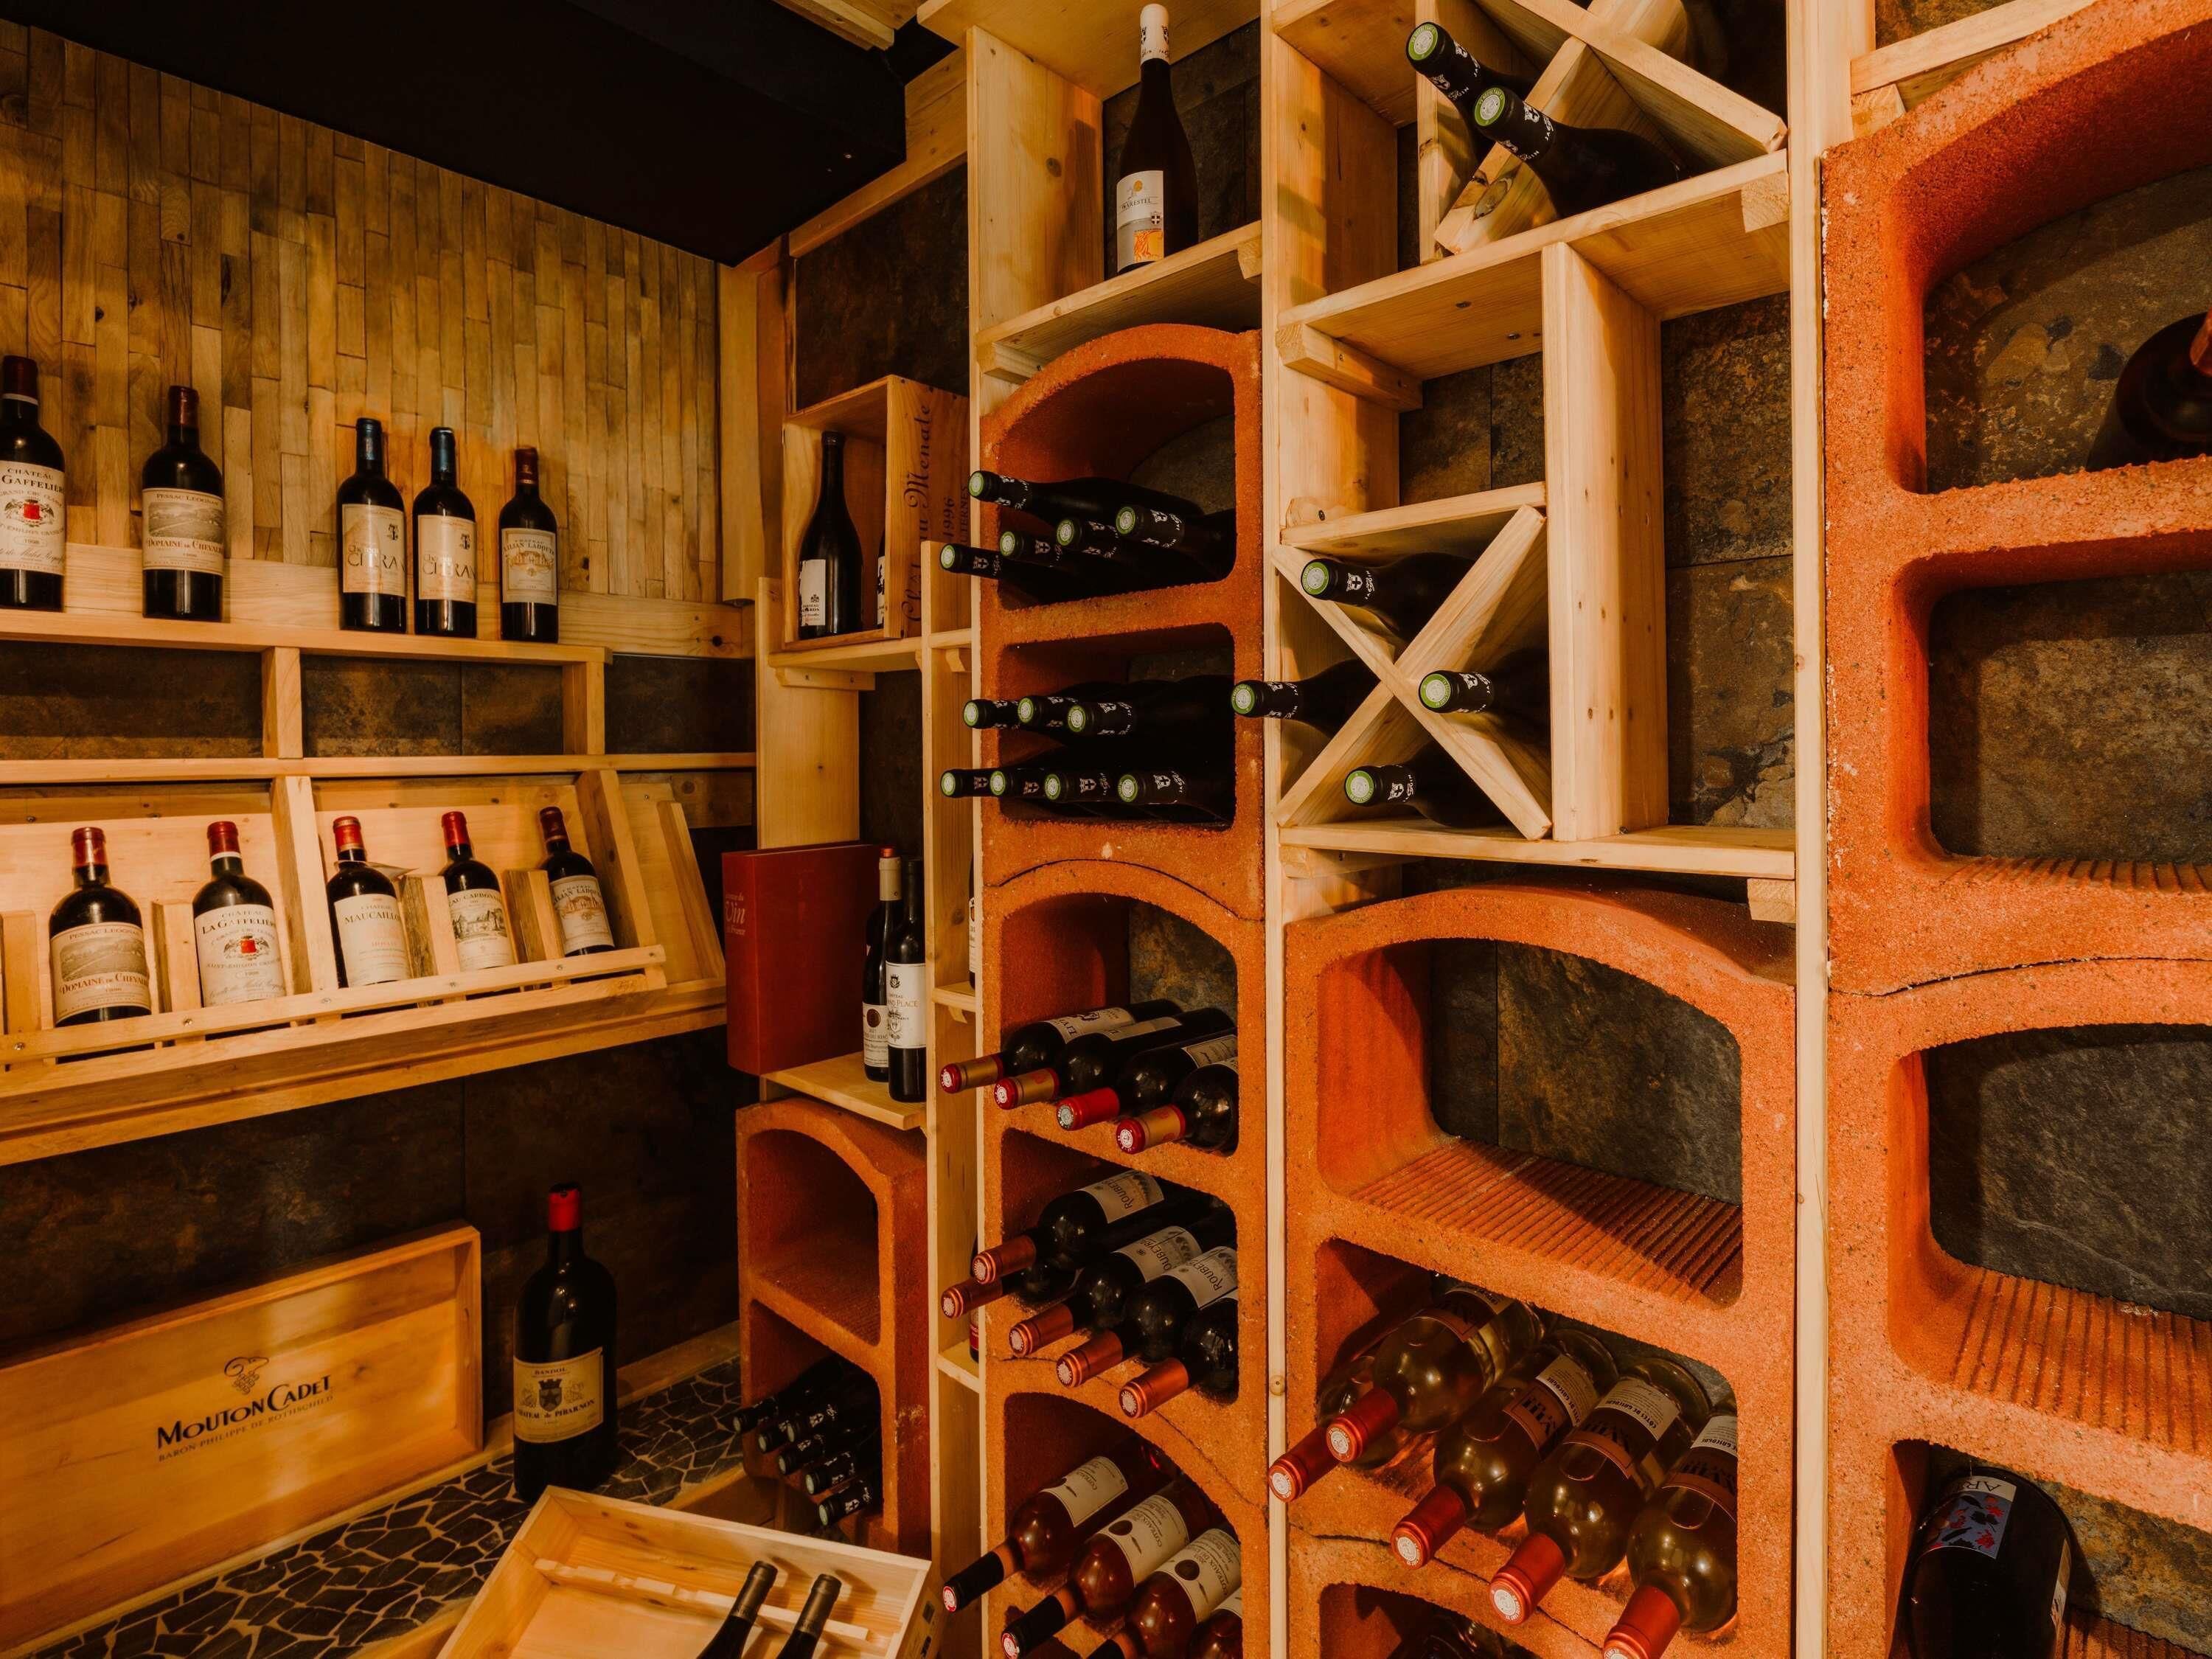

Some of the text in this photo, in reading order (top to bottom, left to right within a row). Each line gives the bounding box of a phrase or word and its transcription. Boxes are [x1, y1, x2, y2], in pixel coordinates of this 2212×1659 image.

[942, 496, 956, 538] 1996
[202, 925, 216, 935] LA
[157, 1375, 332, 1450] MOUTON CADET
[159, 1394, 334, 1462] BARON PHILIPPE DE ROTHSCHILD
